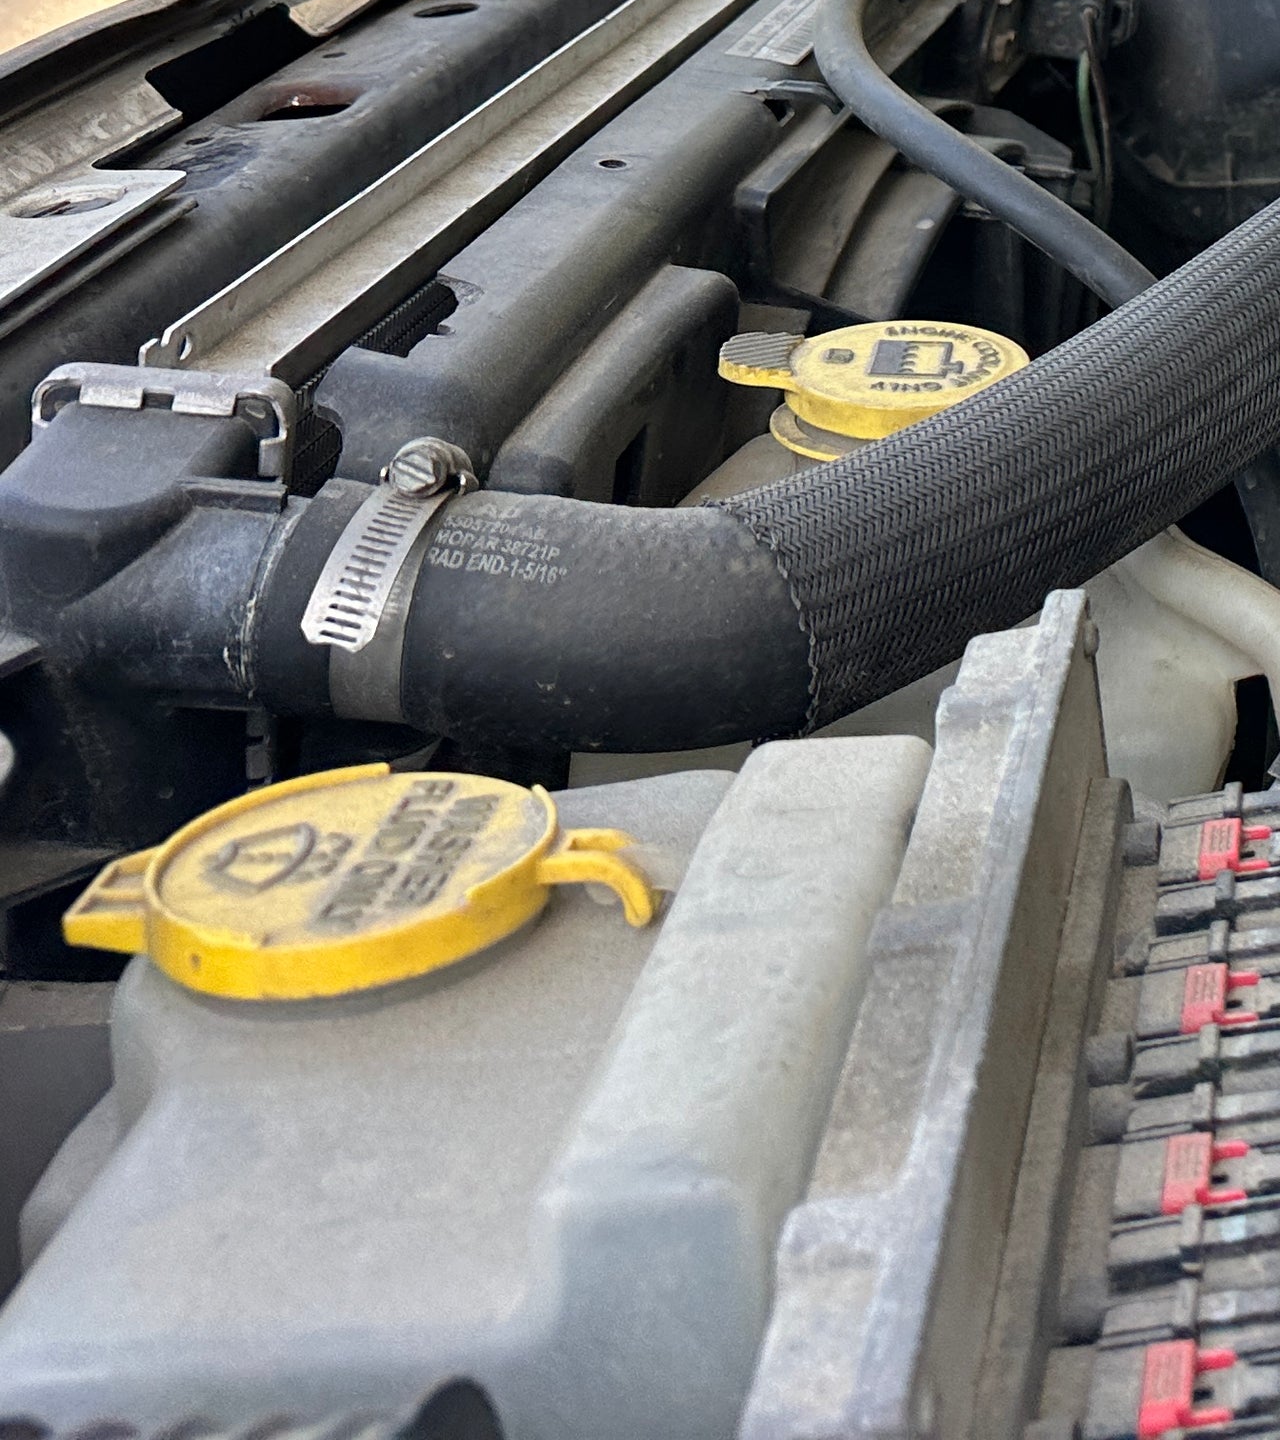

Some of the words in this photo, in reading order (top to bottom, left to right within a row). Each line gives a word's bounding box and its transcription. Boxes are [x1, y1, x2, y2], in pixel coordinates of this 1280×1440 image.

[428, 547, 464, 569] RAD
[434, 528, 500, 552] MOPAR
[501, 538, 561, 561] 38721P
